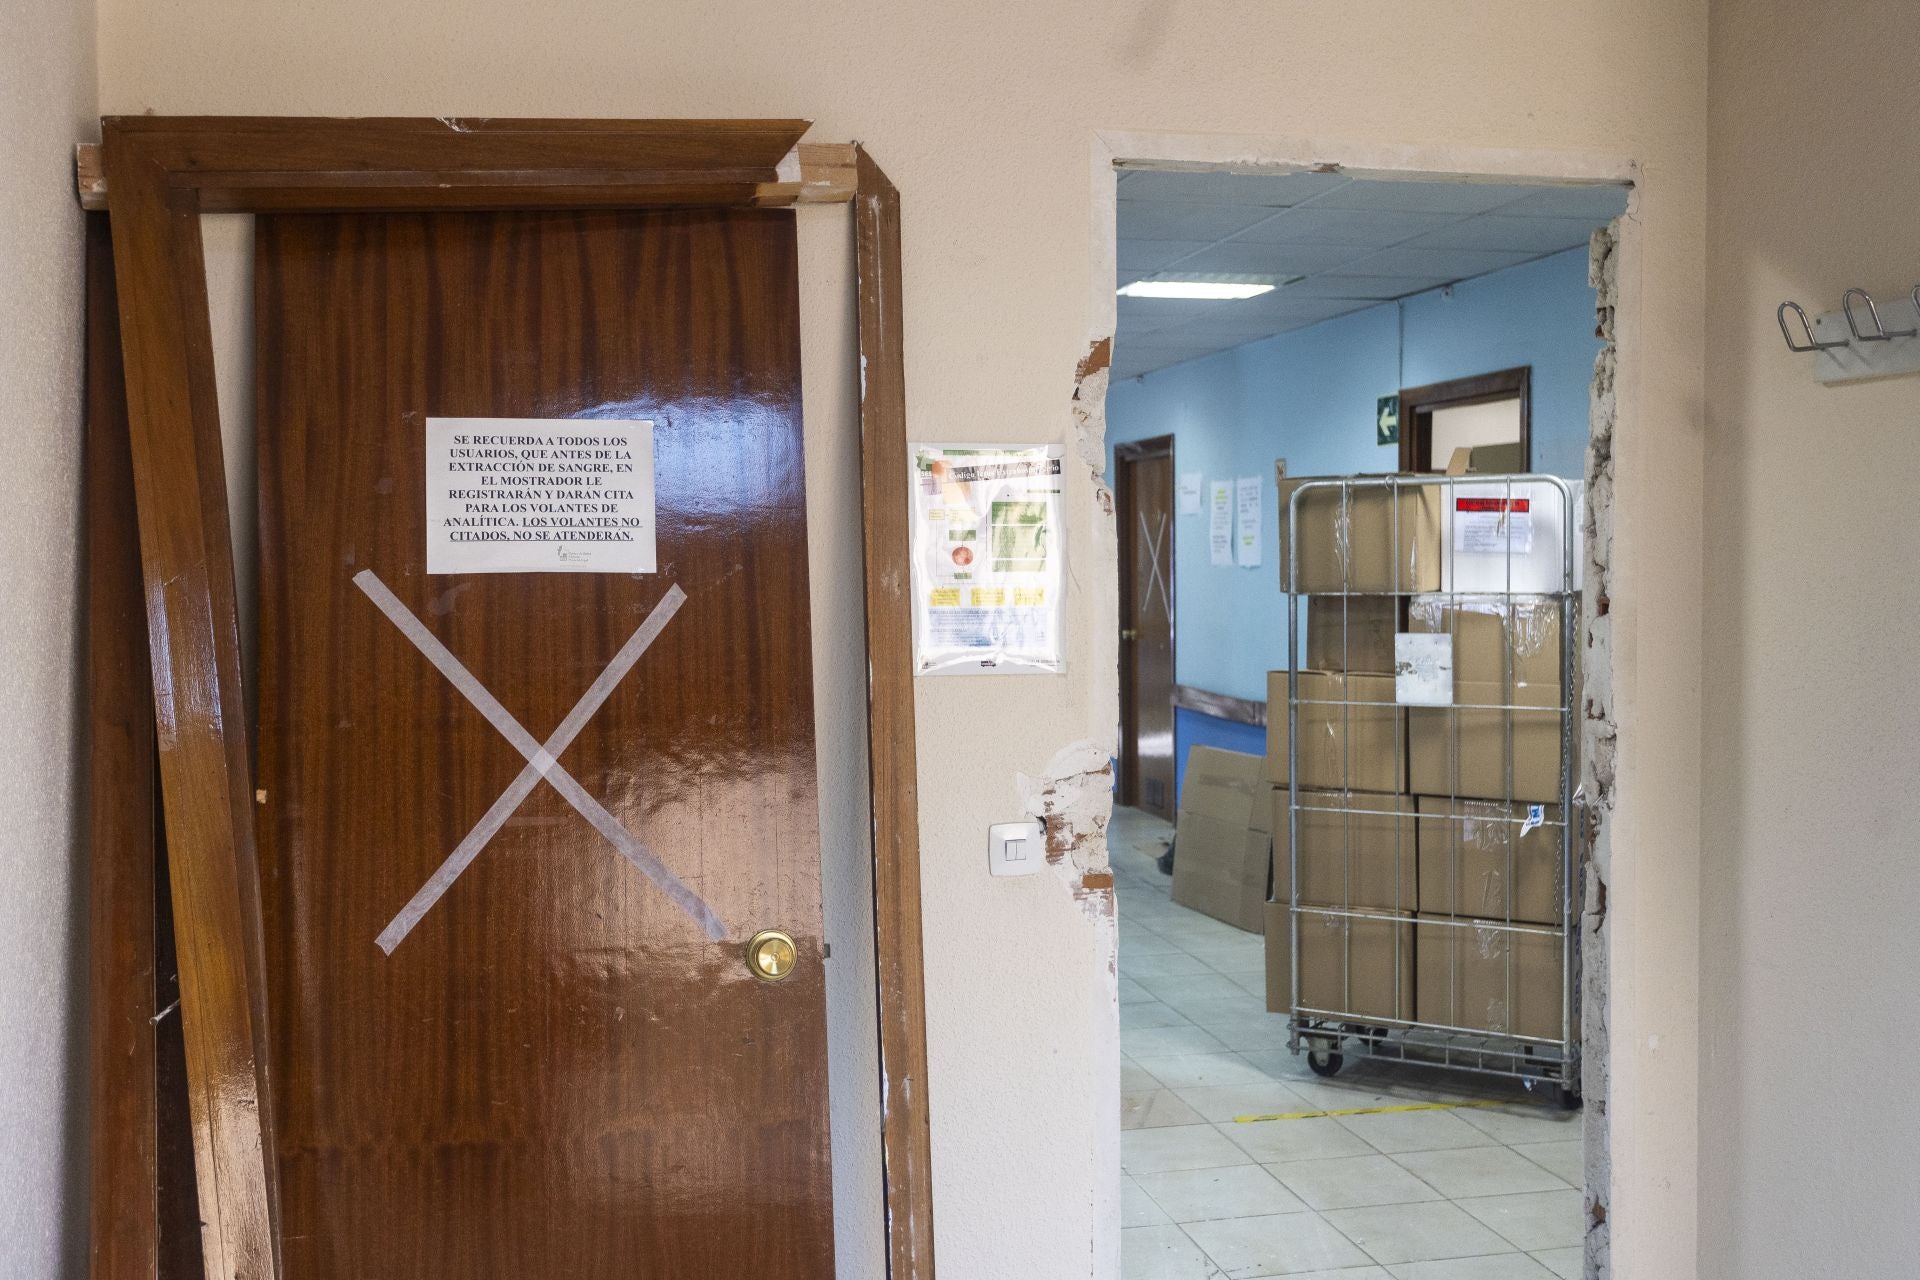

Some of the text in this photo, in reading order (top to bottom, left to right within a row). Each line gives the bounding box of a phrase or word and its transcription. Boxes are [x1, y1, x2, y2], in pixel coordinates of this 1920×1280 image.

[454, 436, 628, 446] SE RECUERDA A TODOS LOS
[450, 448, 632, 460] USUARIOS, QUE ANTES DE LA
[449, 460, 633, 473] EXTRACCIÓN DE SANGRE, EN
[481, 476, 602, 486] EL MOSTRADOR LE
[449, 486, 634, 499] REGISTRARÁN Y DARÁN CITA
[465, 504, 618, 513] PARA LOS VOLANTES DE
[444, 515, 640, 527] ANALÍTICA. LOS VOLANTES NO
[513, 531, 532, 540] NO
[535, 531, 550, 540] SE
[554, 527, 634, 540] ATENDERÁN.
